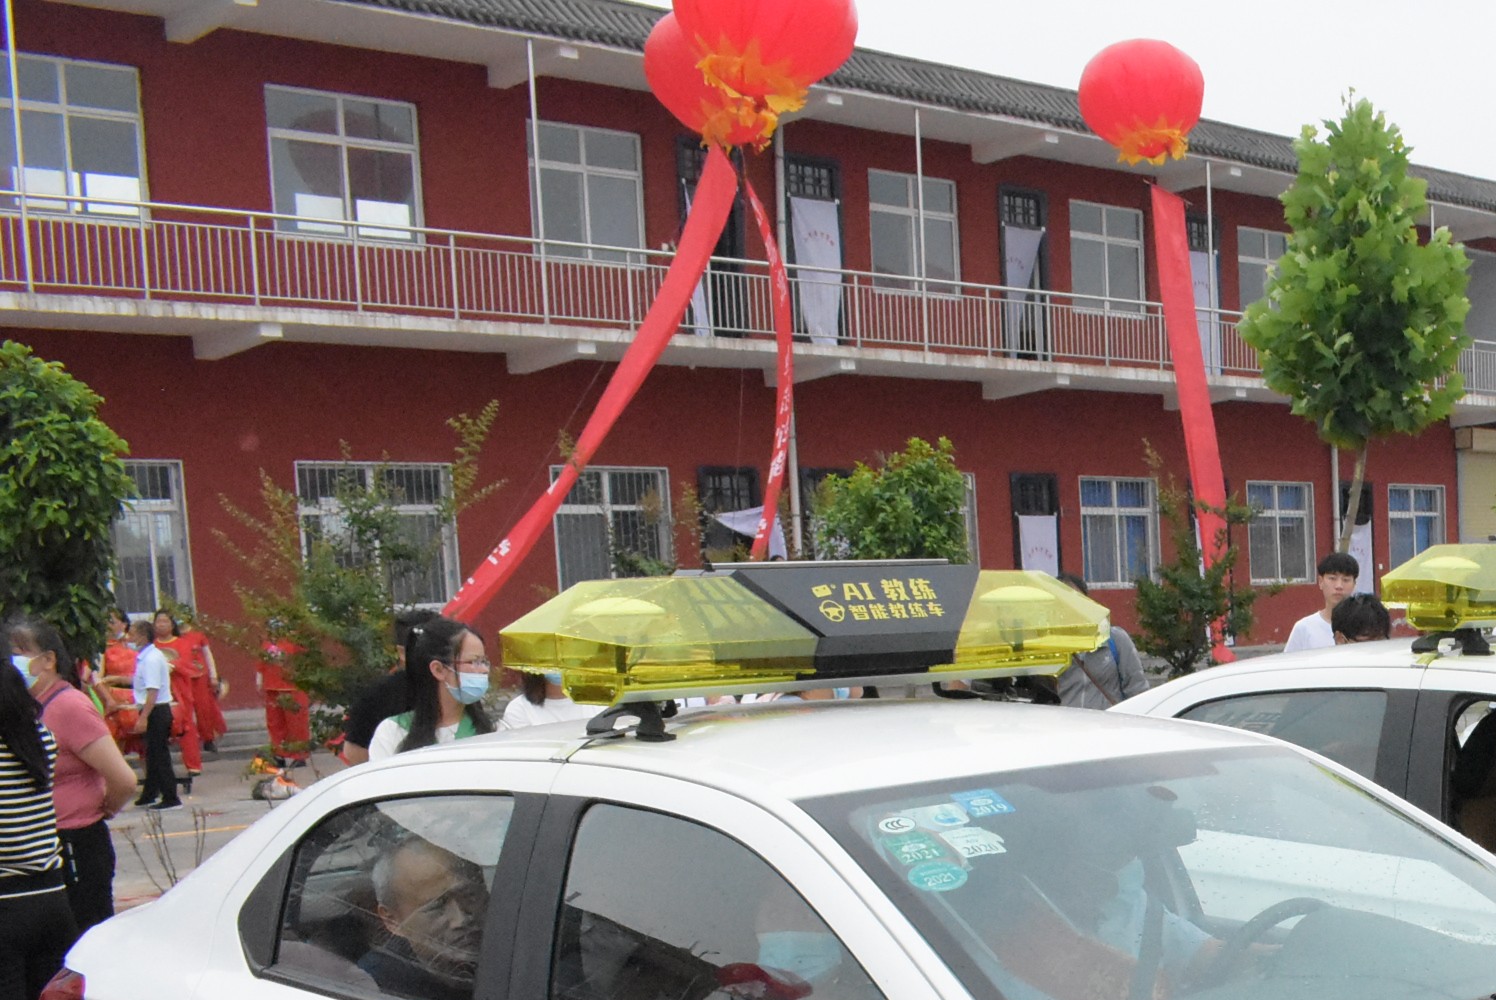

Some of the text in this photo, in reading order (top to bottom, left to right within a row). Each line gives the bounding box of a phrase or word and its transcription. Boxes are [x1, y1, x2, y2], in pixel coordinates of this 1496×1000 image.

[842, 578, 938, 601] AI 教练
[848, 601, 946, 621] 智能教练车
[970, 803, 1008, 816] 2019
[902, 848, 941, 864] 2021
[963, 844, 999, 855] 2020
[924, 872, 956, 887] 2021
